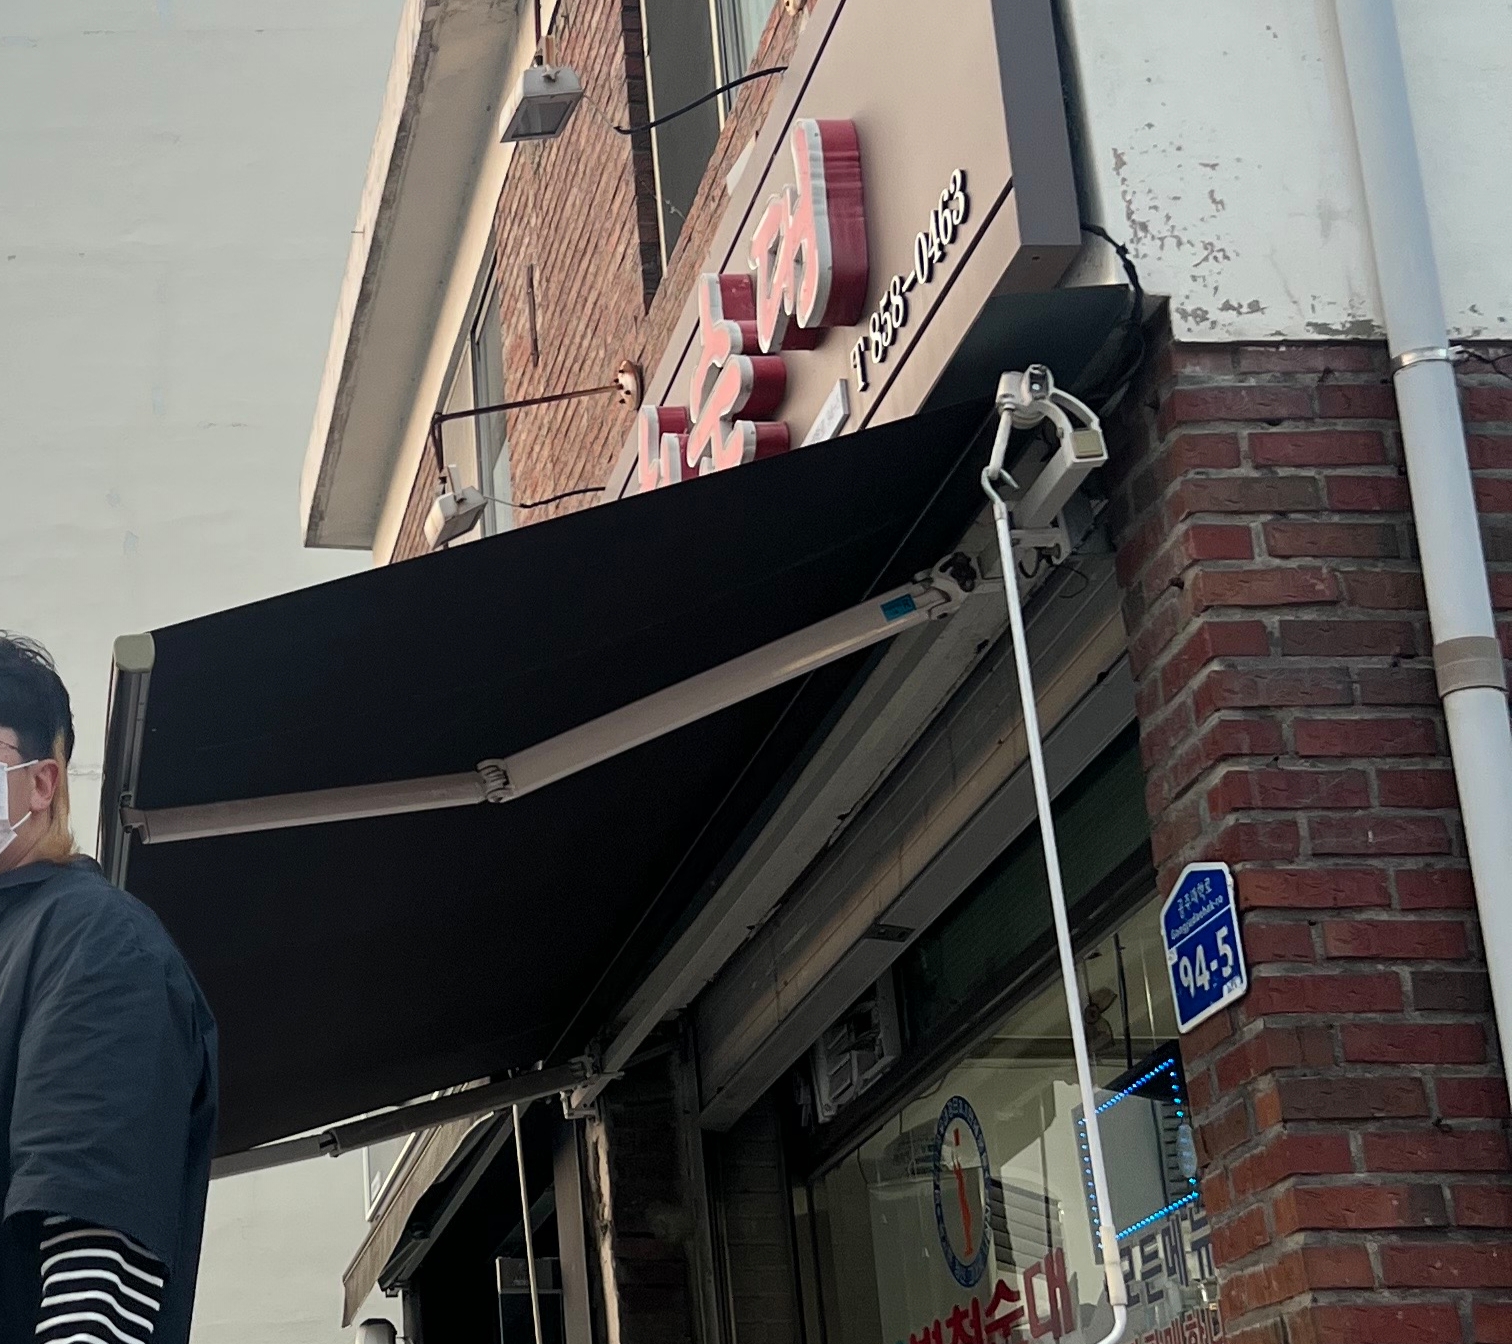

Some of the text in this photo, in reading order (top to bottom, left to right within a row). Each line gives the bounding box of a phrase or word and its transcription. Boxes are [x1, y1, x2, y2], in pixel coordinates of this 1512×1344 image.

[851, 168, 969, 392] T 858-0463
[1179, 925, 1234, 998] 94-5
